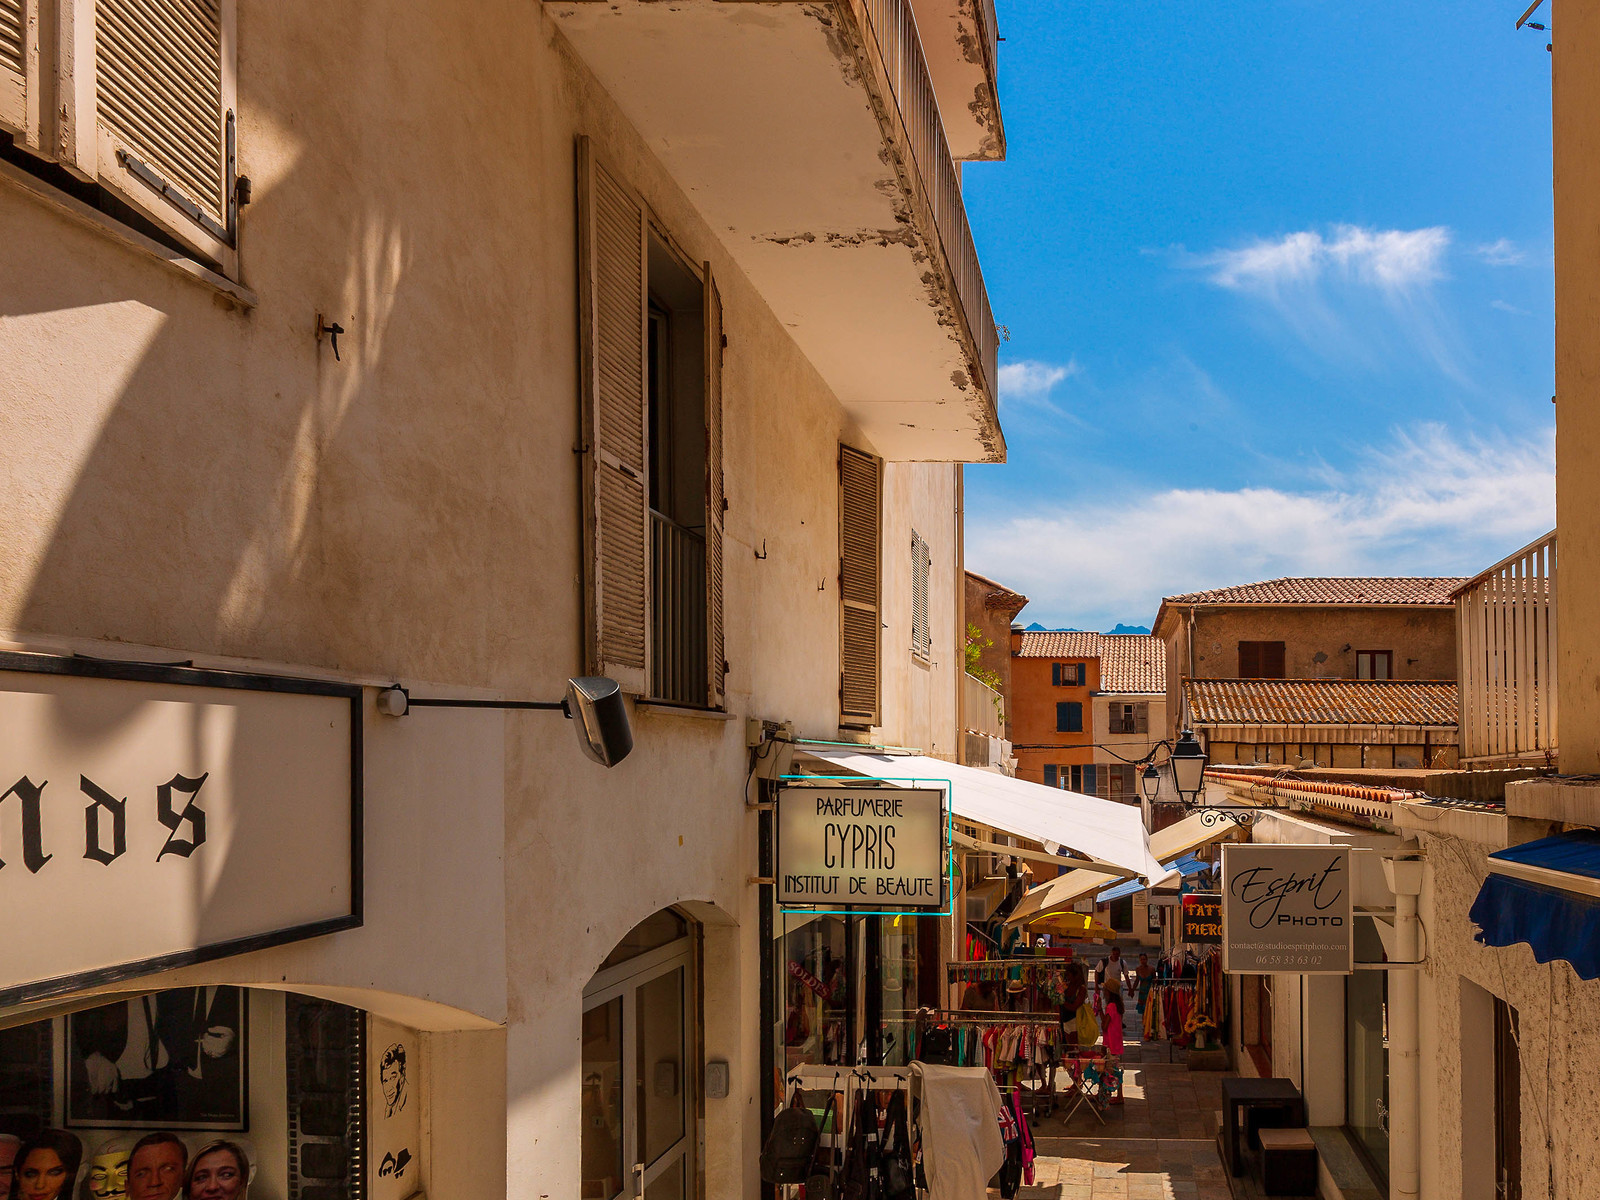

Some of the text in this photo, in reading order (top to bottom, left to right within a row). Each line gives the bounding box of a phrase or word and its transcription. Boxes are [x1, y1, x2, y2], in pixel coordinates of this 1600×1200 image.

[816, 796, 903, 818] PARFUMERIE
[824, 823, 896, 870] CYPRIS
[784, 875, 934, 897] INSTITUT DE BEAUTE
[1231, 856, 1342, 929] Esprit
[1229, 941, 1347, 952] contact@studioespritphoto.com
[1255, 955, 1322, 965] 06 58 33 63 02
[788, 961, 831, 998] SOLDES
